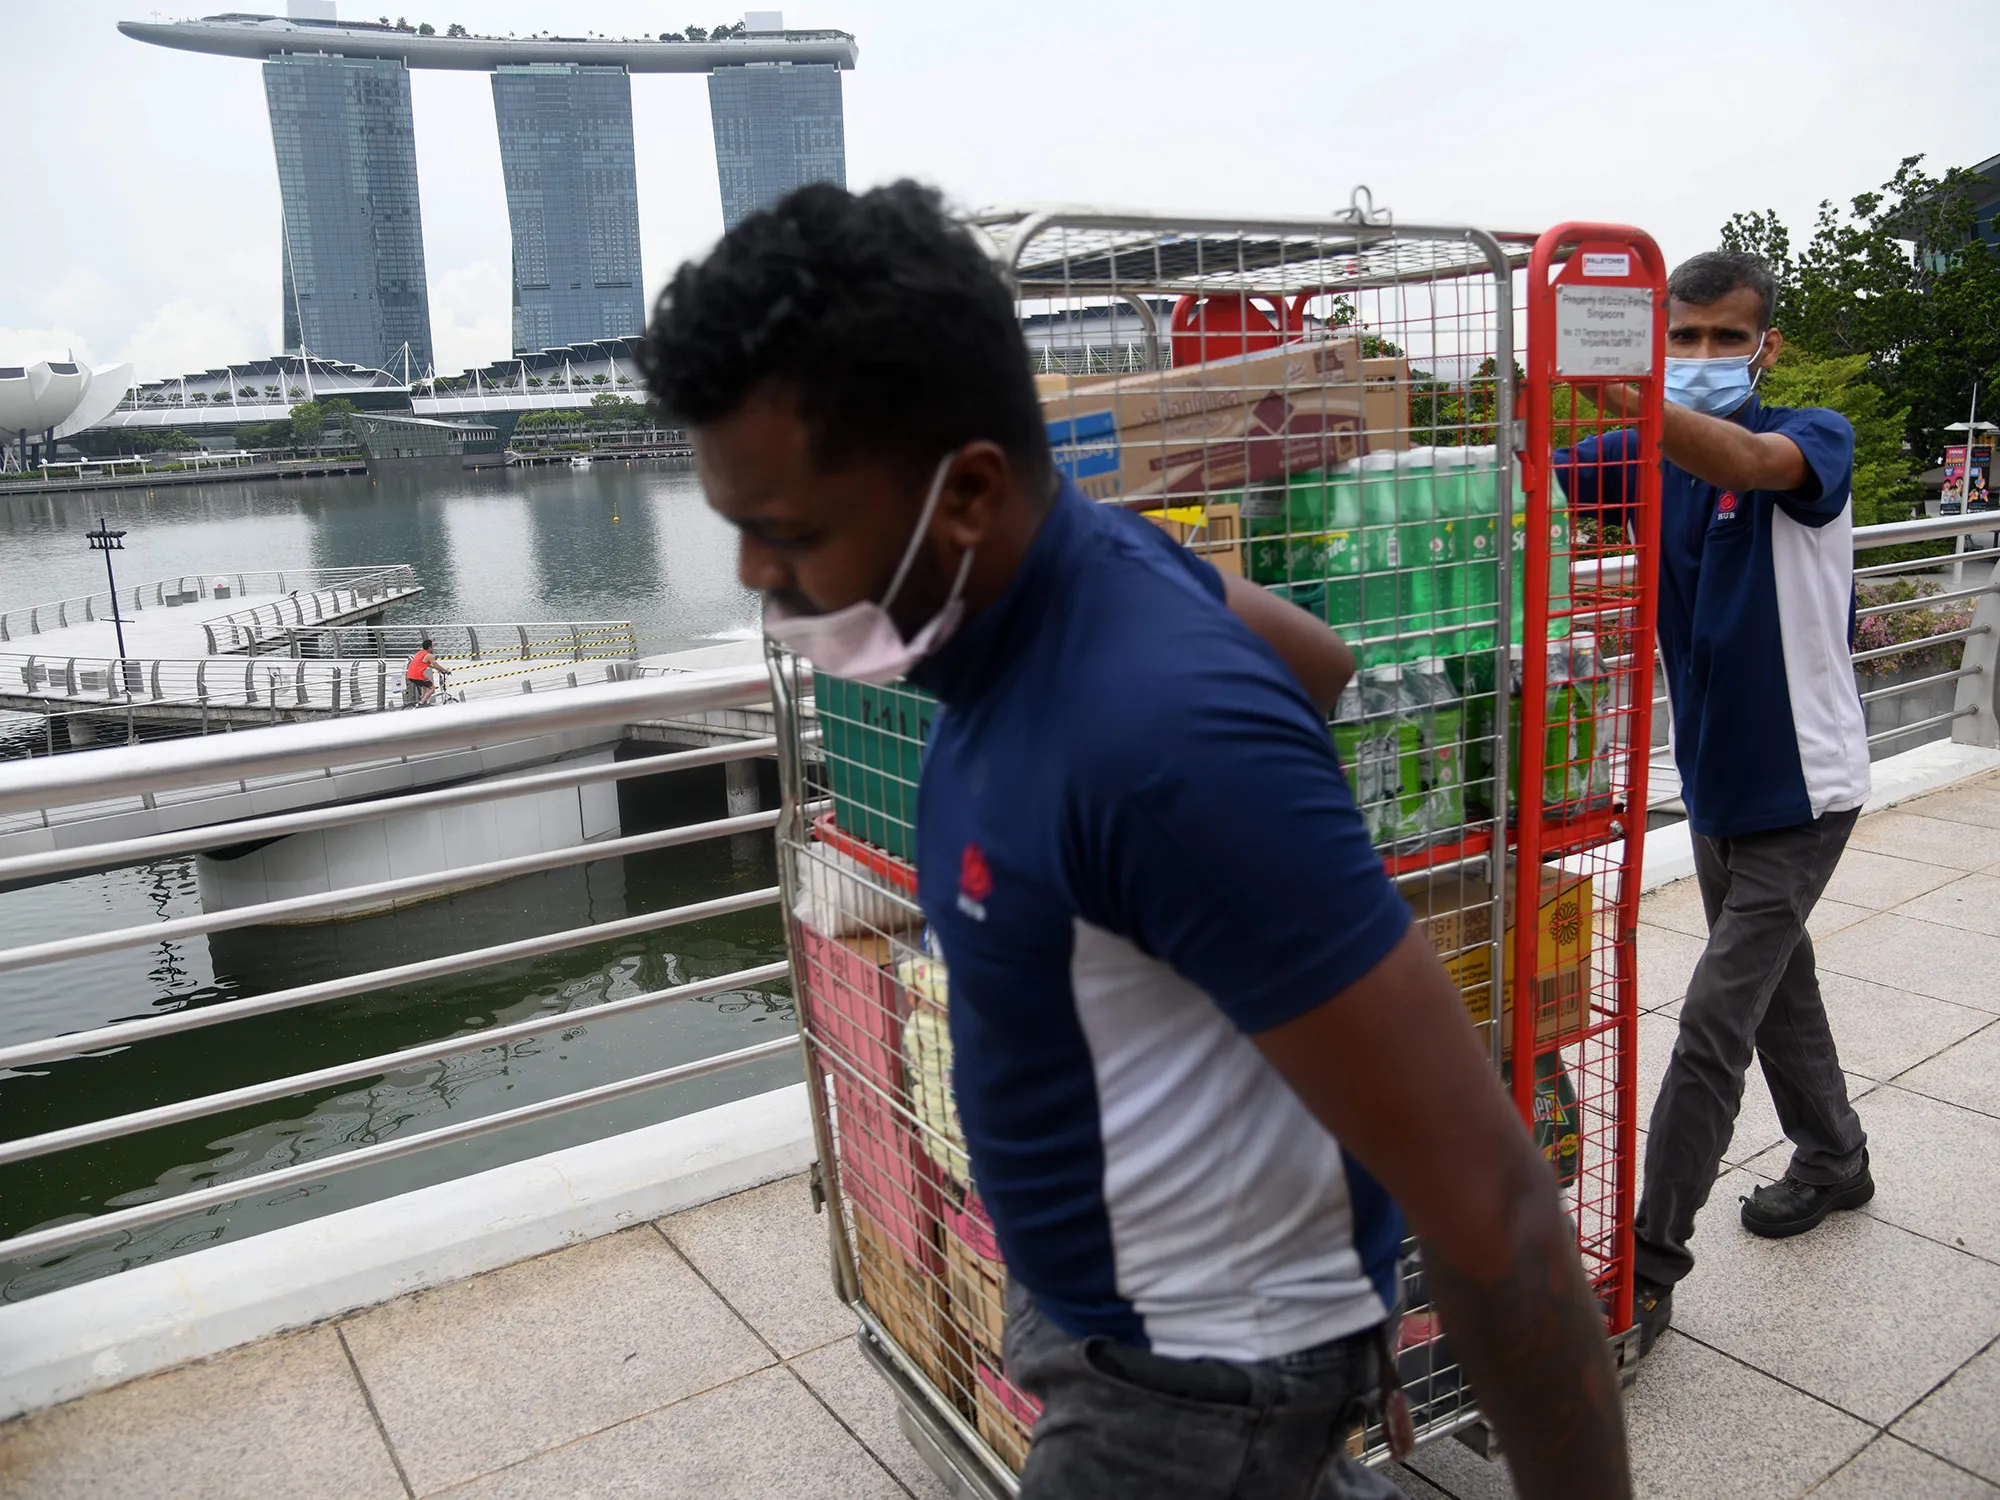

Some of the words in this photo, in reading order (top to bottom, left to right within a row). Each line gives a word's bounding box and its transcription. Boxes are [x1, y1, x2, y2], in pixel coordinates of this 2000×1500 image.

[1562, 294, 1596, 307] Property
[1598, 295, 1606, 305] of
[1586, 308, 1625, 320] Singapore
